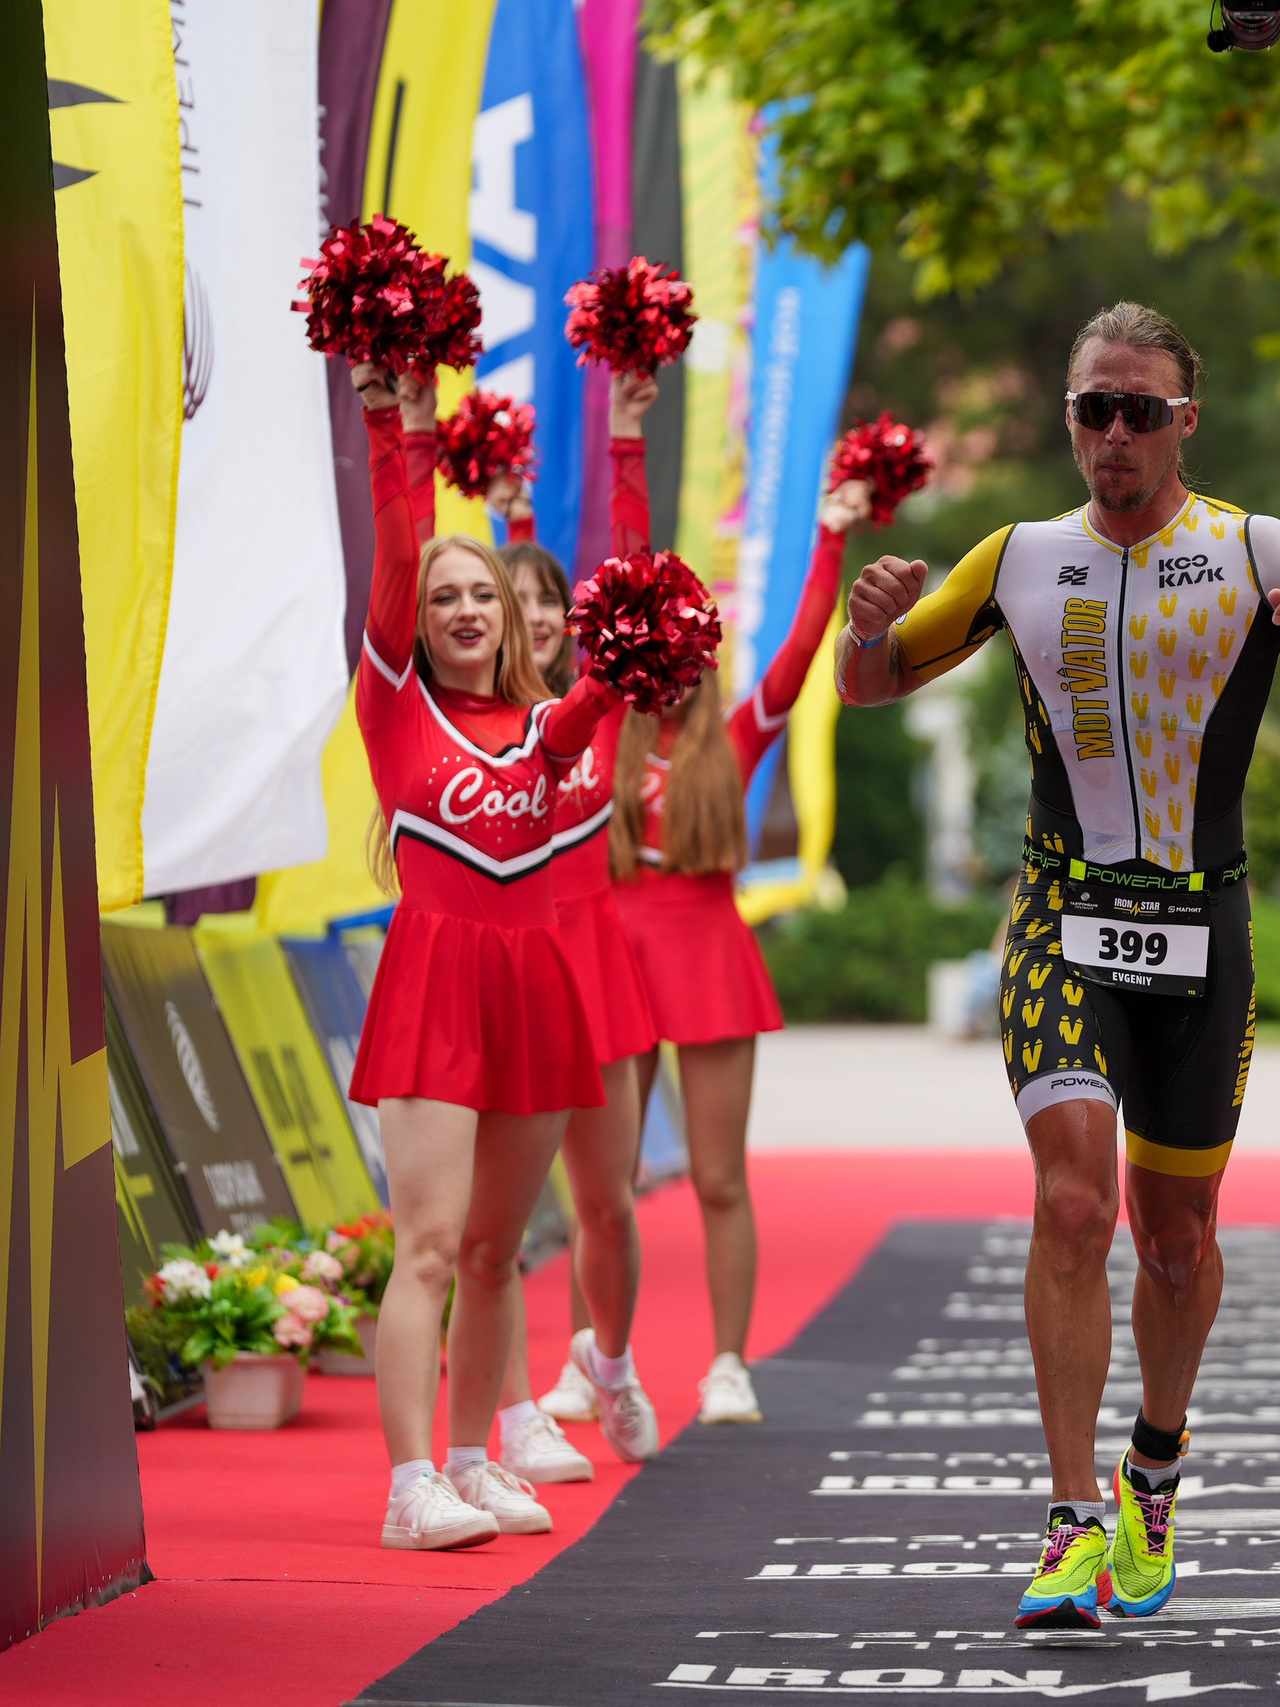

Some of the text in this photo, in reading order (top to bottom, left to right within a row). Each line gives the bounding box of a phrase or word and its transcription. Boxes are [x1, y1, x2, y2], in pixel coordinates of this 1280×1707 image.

[1158, 567, 1225, 589] KASK
[438, 766, 549, 825] Cool
[1086, 865, 1190, 890] POWERUP
[1114, 897, 1160, 911] IRON STAR
[1175, 906, 1202, 914] МАГНИТ
[1098, 927, 1168, 966] 399
[1112, 971, 1153, 986] EVGENIY
[666, 1663, 1063, 1687] IRON
